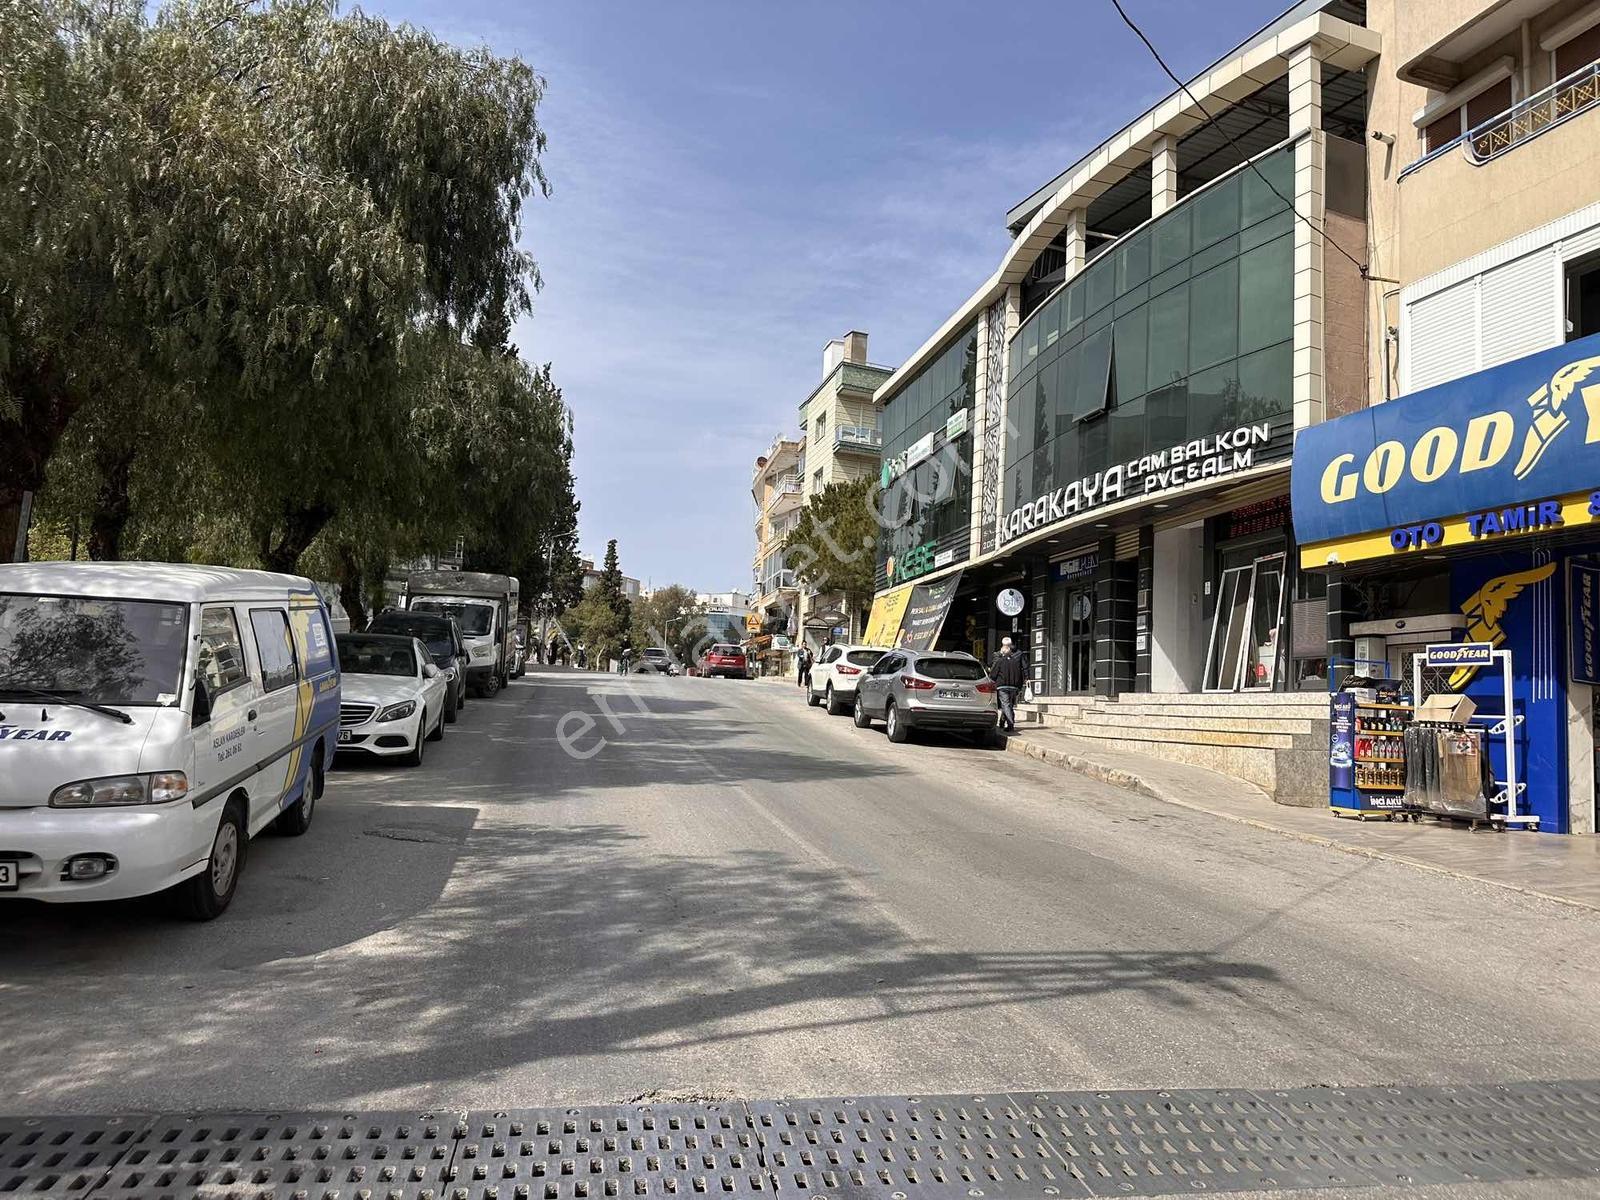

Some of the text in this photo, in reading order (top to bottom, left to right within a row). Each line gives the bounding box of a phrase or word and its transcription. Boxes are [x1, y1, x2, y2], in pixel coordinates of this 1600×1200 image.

[1127, 423, 1270, 478] CAM BALKON
[1001, 464, 1125, 541] KARAKAYA
[1390, 522, 1444, 549] OTO
[1581, 573, 1594, 677] GOODYEAR
[1430, 647, 1489, 661] GOODYEAR
[1386, 796, 1402, 806] AKÜ
[0, 865, 10, 883] 3
